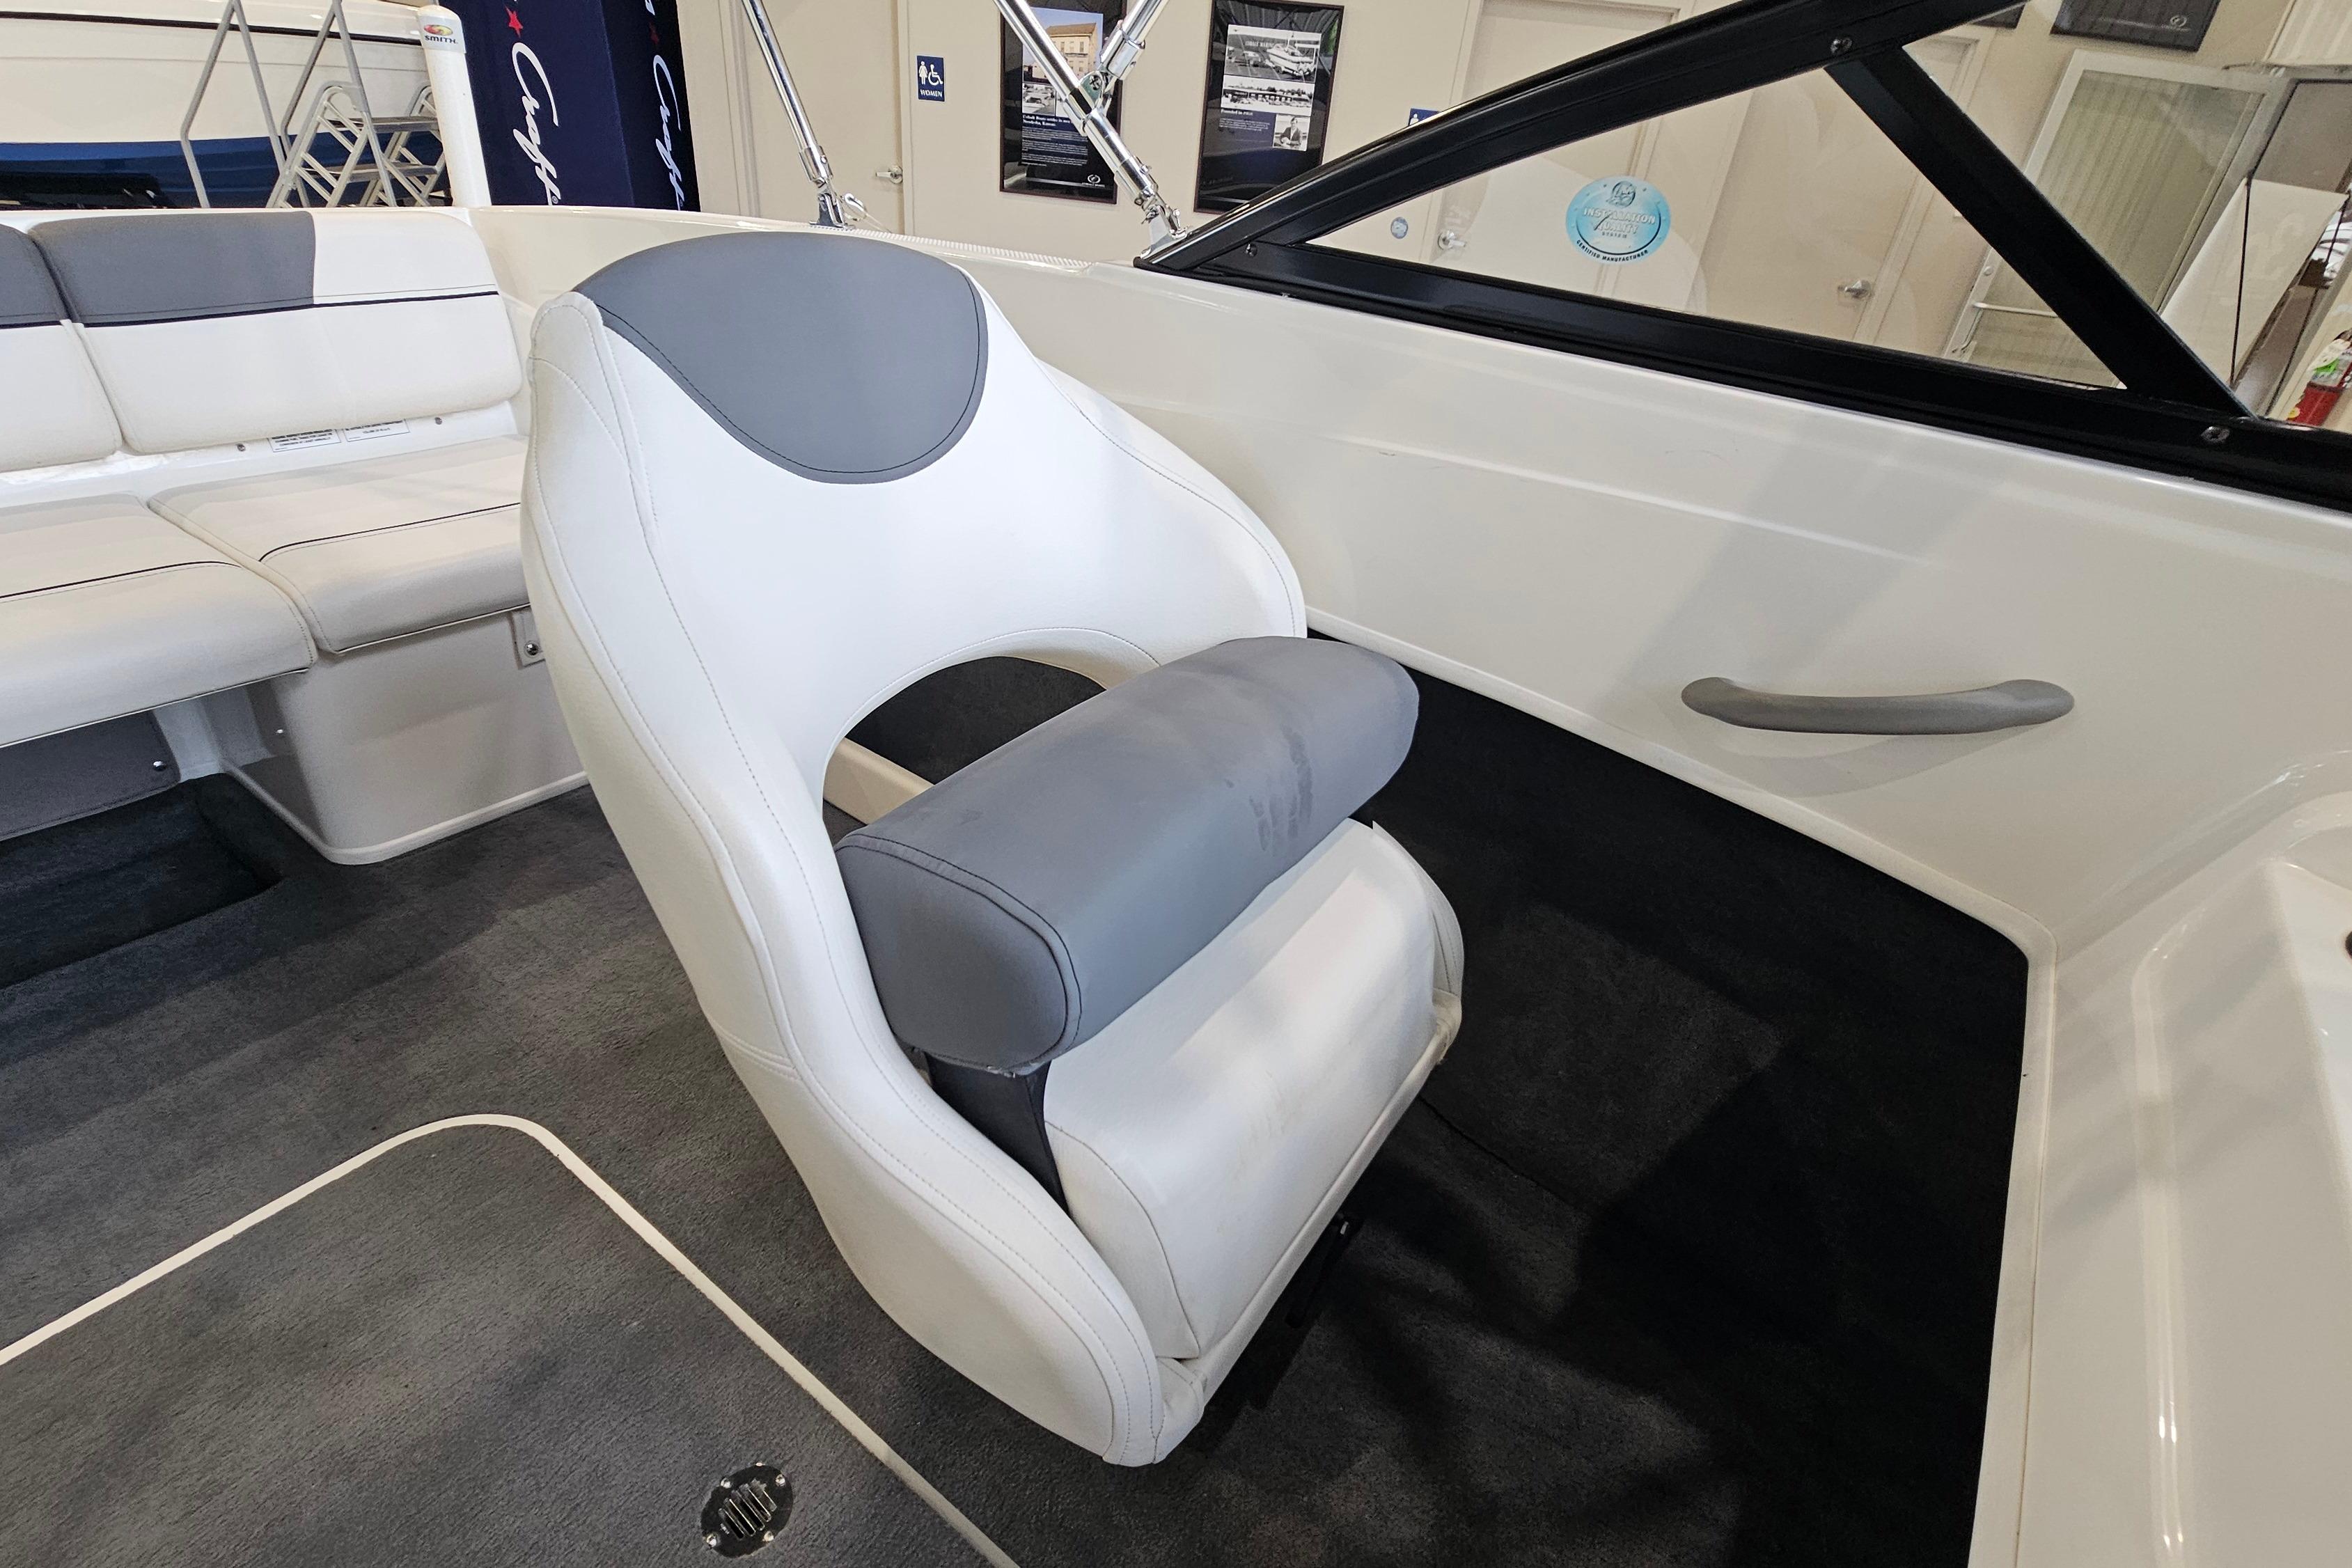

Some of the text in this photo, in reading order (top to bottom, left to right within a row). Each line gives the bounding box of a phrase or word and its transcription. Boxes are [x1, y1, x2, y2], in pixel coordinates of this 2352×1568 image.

[425, 35, 457, 44] SMITH
[920, 88, 943, 97] WOMEN
[1584, 208, 1655, 224] INSTALLATION
[1576, 240, 1648, 262] CERTIFIED MANUFACTURER
